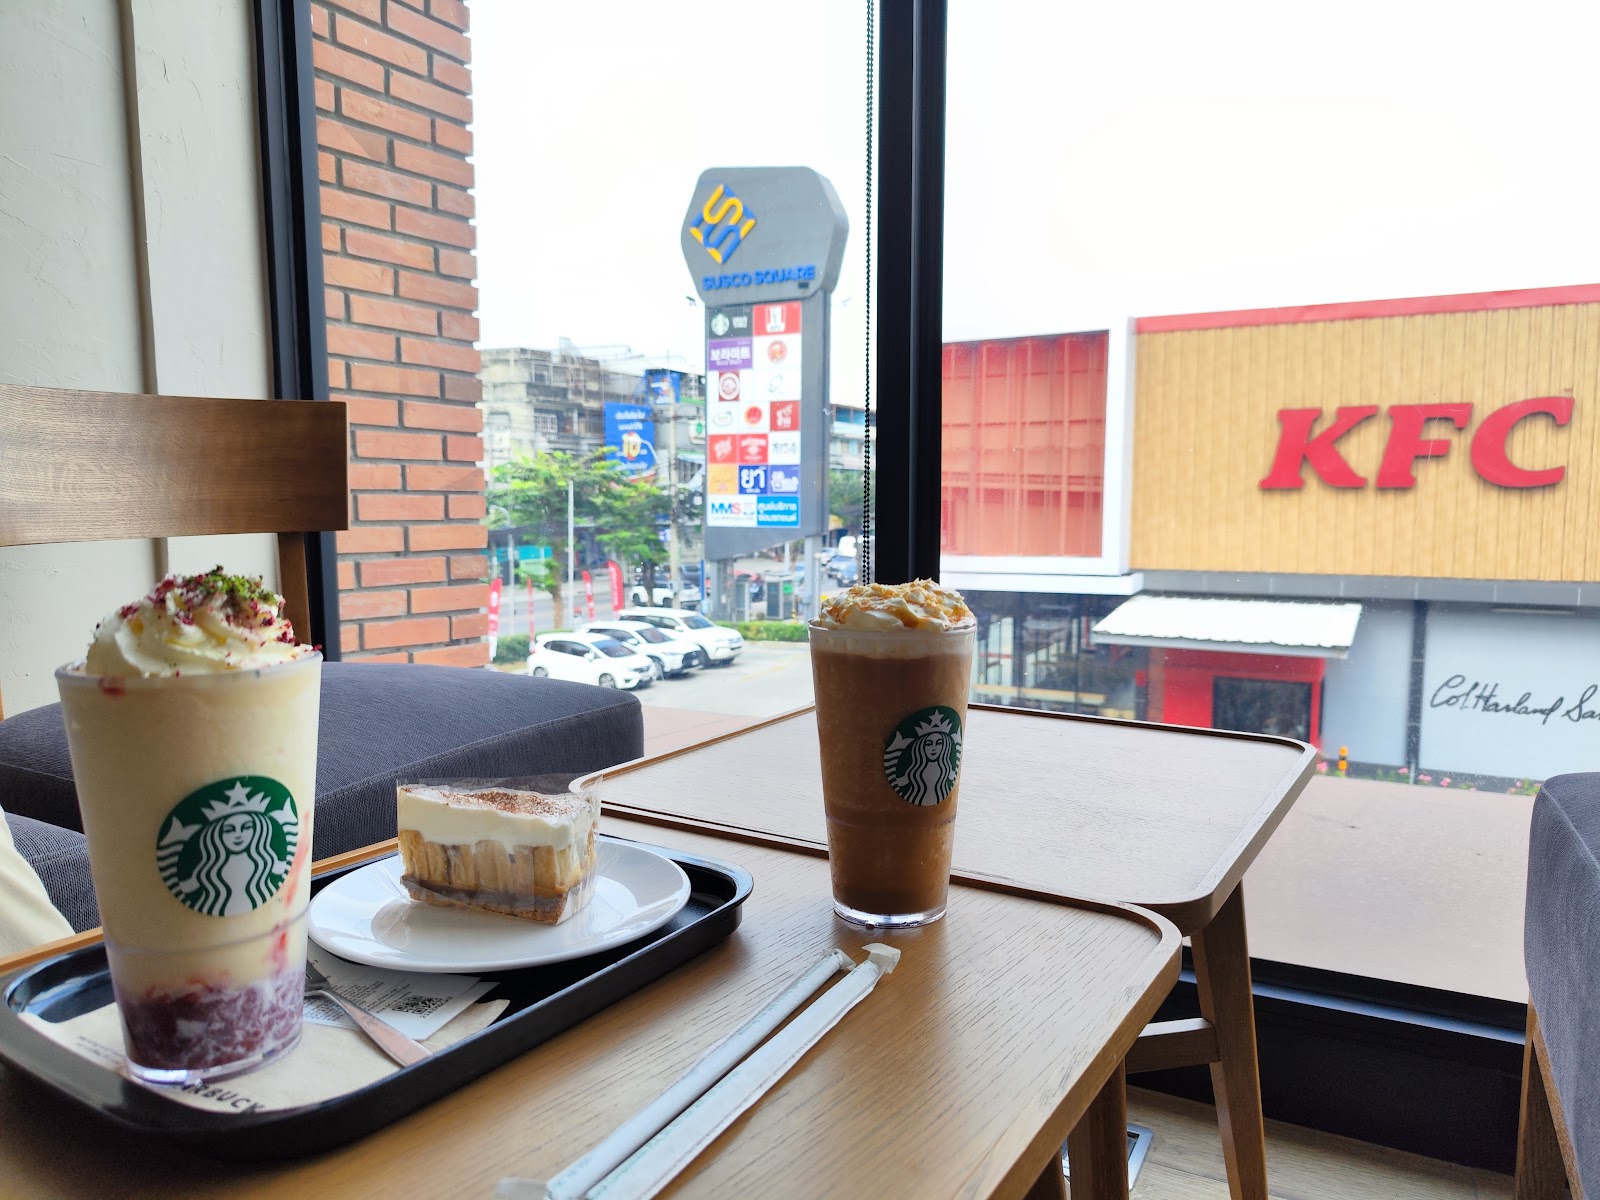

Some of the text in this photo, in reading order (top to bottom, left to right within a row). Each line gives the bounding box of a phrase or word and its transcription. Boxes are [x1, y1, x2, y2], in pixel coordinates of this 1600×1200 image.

[702, 265, 816, 291] SUSCO SQUARE
[1258, 396, 1575, 489] KFC
[711, 502, 741, 515] MMS
